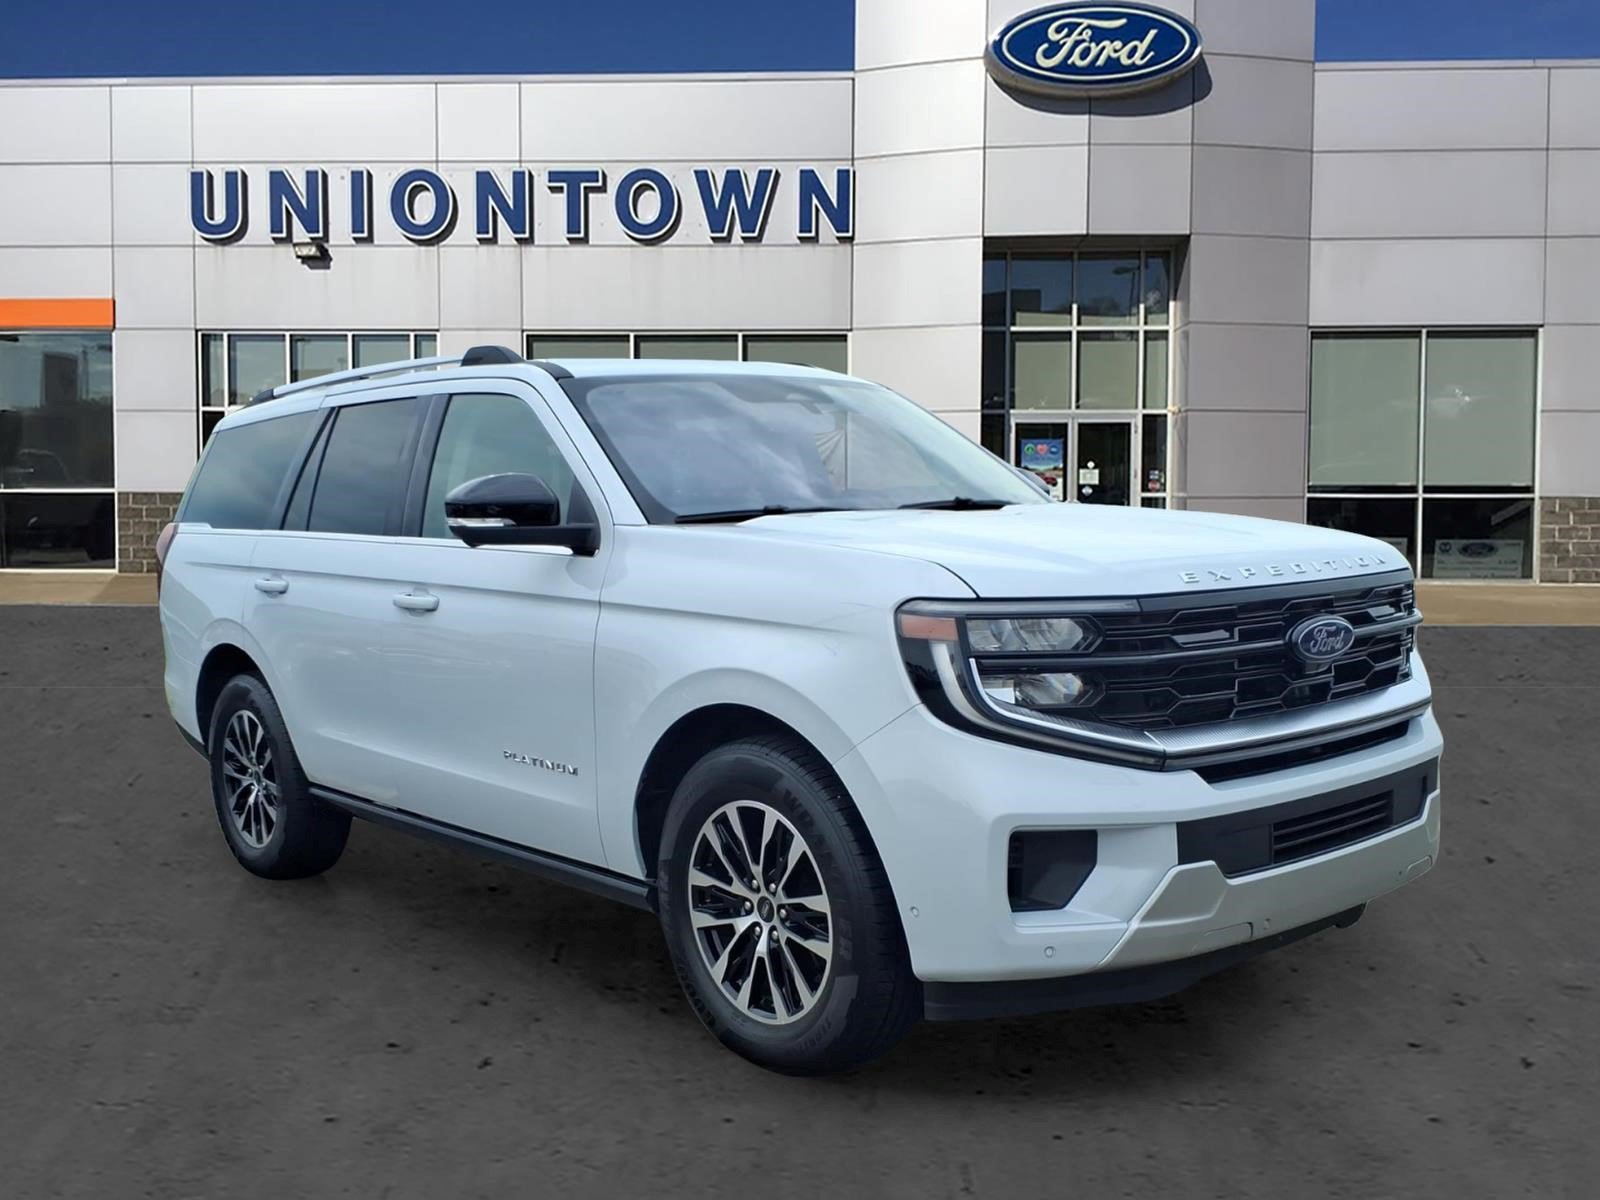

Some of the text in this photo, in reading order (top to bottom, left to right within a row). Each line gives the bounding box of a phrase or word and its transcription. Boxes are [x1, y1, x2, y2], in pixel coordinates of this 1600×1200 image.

[1036, 16, 1159, 68] Ford
[190, 166, 855, 243] UNIONTOWN
[1178, 553, 1387, 583] EXPEDITION
[1310, 624, 1345, 652] Ford
[503, 750, 579, 776] PLATINUM
